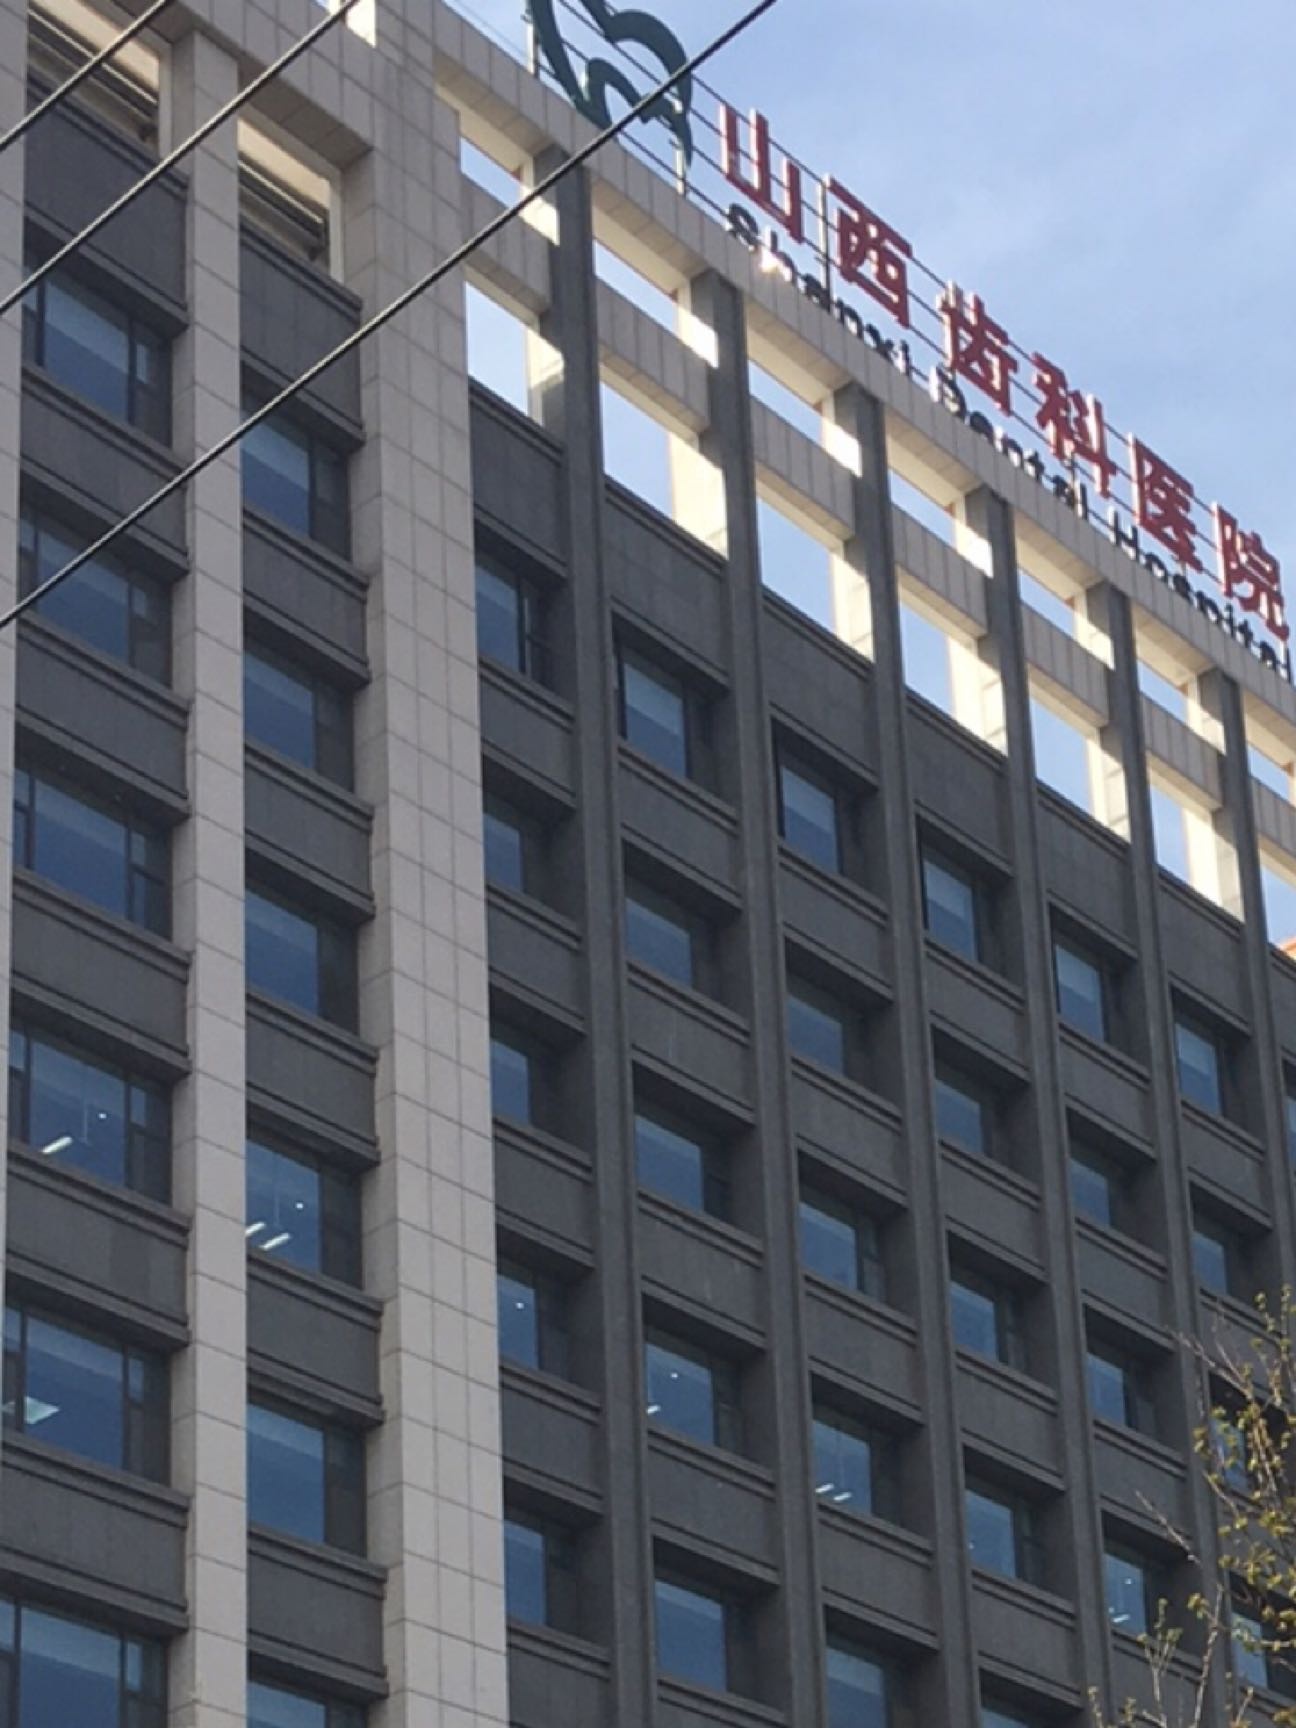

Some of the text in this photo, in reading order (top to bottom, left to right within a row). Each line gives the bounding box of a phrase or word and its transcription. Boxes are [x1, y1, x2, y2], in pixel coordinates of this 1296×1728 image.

[719, 100, 1290, 642] 山西齿科医院
